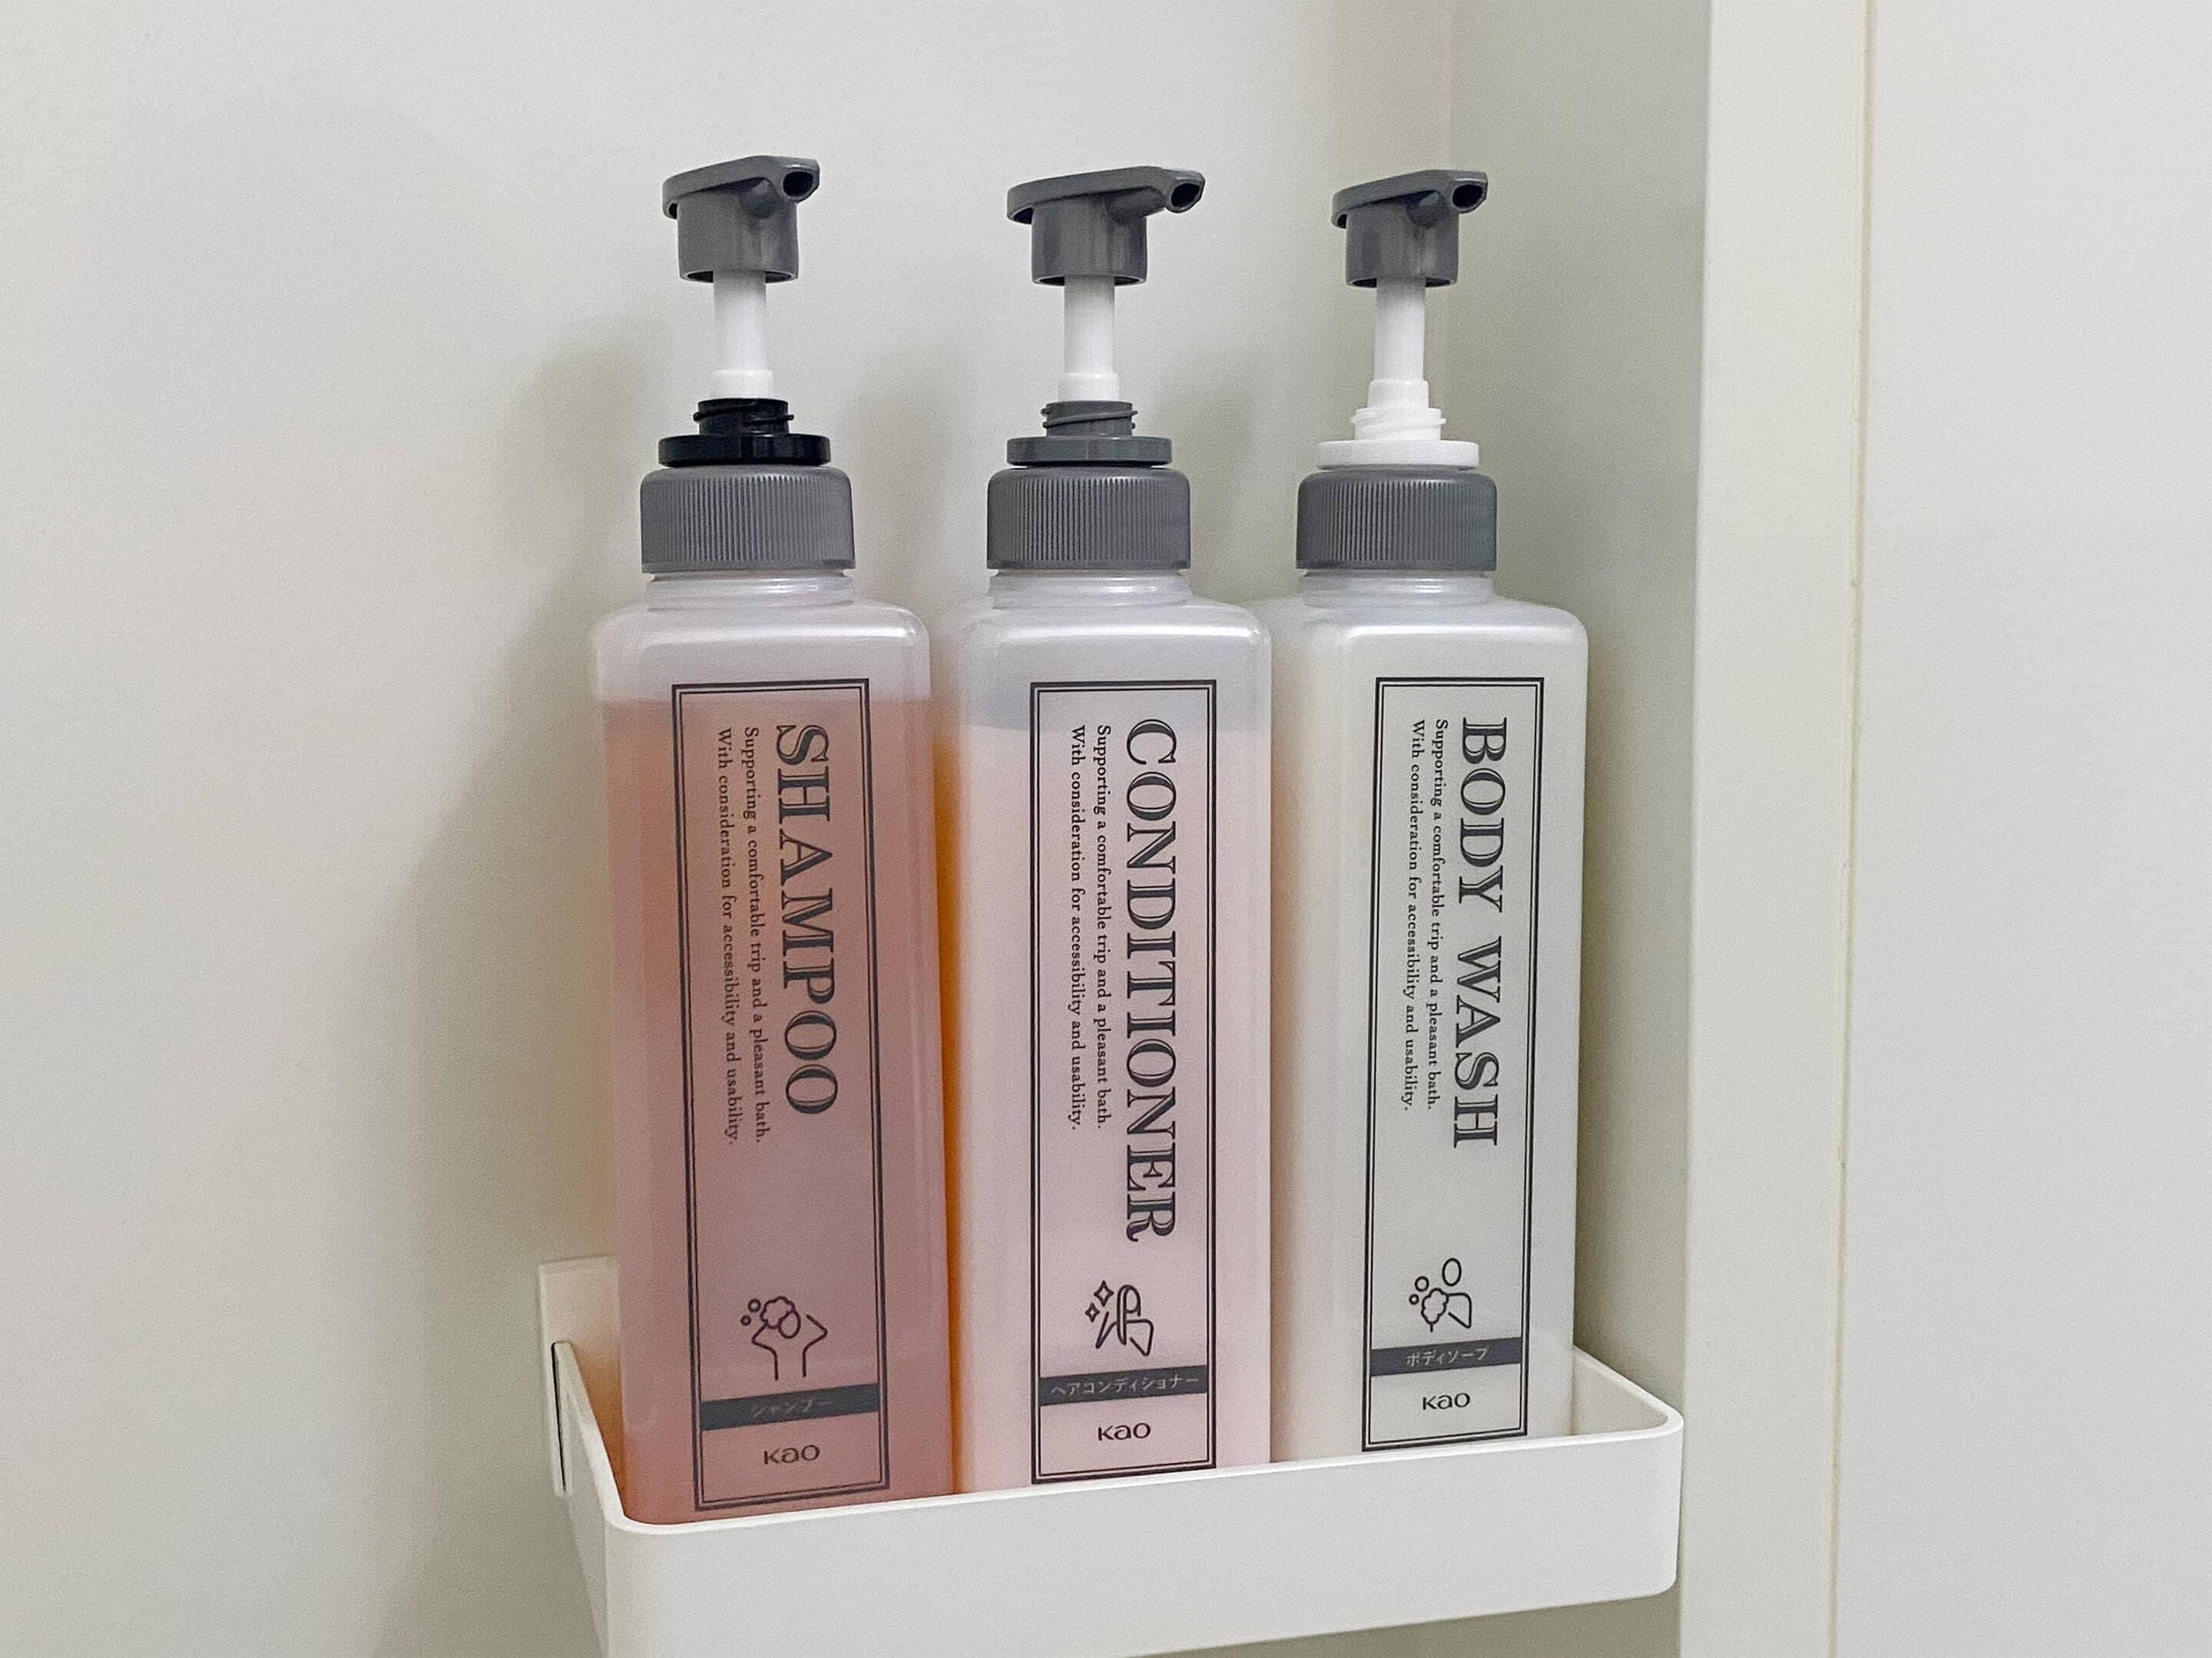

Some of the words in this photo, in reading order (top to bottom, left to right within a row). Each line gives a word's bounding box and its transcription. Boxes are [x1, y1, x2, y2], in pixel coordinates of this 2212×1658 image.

[717, 726, 734, 769] With
[1071, 723, 1088, 766] With
[1411, 718, 1426, 760] With
[740, 726, 762, 820] Supporting
[1092, 724, 1112, 816] Supporting
[1429, 718, 1449, 808] Supporting
[718, 775, 736, 889] consideration
[747, 825, 757, 835] a
[1071, 771, 1087, 882] consideration
[1097, 820, 1107, 830] a
[1409, 763, 1424, 871] consideration
[1433, 811, 1442, 822] a
[1457, 716, 1508, 914] BODY
[747, 839, 766, 937] comfortable
[1093, 834, 1112, 930] comfortable
[1408, 875, 1422, 900] for
[1431, 825, 1446, 918] comfortable
[721, 895, 738, 919] for
[775, 724, 839, 1115] SHAMPOO
[1071, 887, 1087, 912] for
[747, 942, 767, 973] trip
[1092, 934, 1111, 965] trip
[1402, 904, 1421, 1001] accessibility
[1426, 922, 1444, 951] trip
[723, 924, 740, 1027] accessibility
[1067, 915, 1087, 1016] accessibility
[1097, 968, 1113, 999] and
[1125, 718, 1177, 1243] CONDITIONER
[1429, 955, 1444, 985] and
[751, 978, 769, 1009] and
[1097, 1003, 1107, 1014] a
[1429, 988, 1439, 998] a
[753, 1013, 763, 1024] a
[1071, 1020, 1088, 1051] and
[1405, 1004, 1419, 1034] and
[1425, 1001, 1443, 1067] pleasant
[726, 1031, 742, 1063] and
[749, 1028, 769, 1096] pleasant
[1092, 1017, 1112, 1084] pleasant
[1452, 935, 1502, 1150] WASH
[1067, 1055, 1087, 1130] usability.
[1400, 1038, 1419, 1111] usability.
[1427, 1071, 1442, 1110] bath.
[727, 1068, 743, 1144] usability.
[755, 1100, 771, 1143] bath.
[1097, 1087, 1112, 1129] bath.
[1406, 1345, 1490, 1368] ボディソープ
[1050, 1373, 1200, 1397] ヘアコンディショナー
